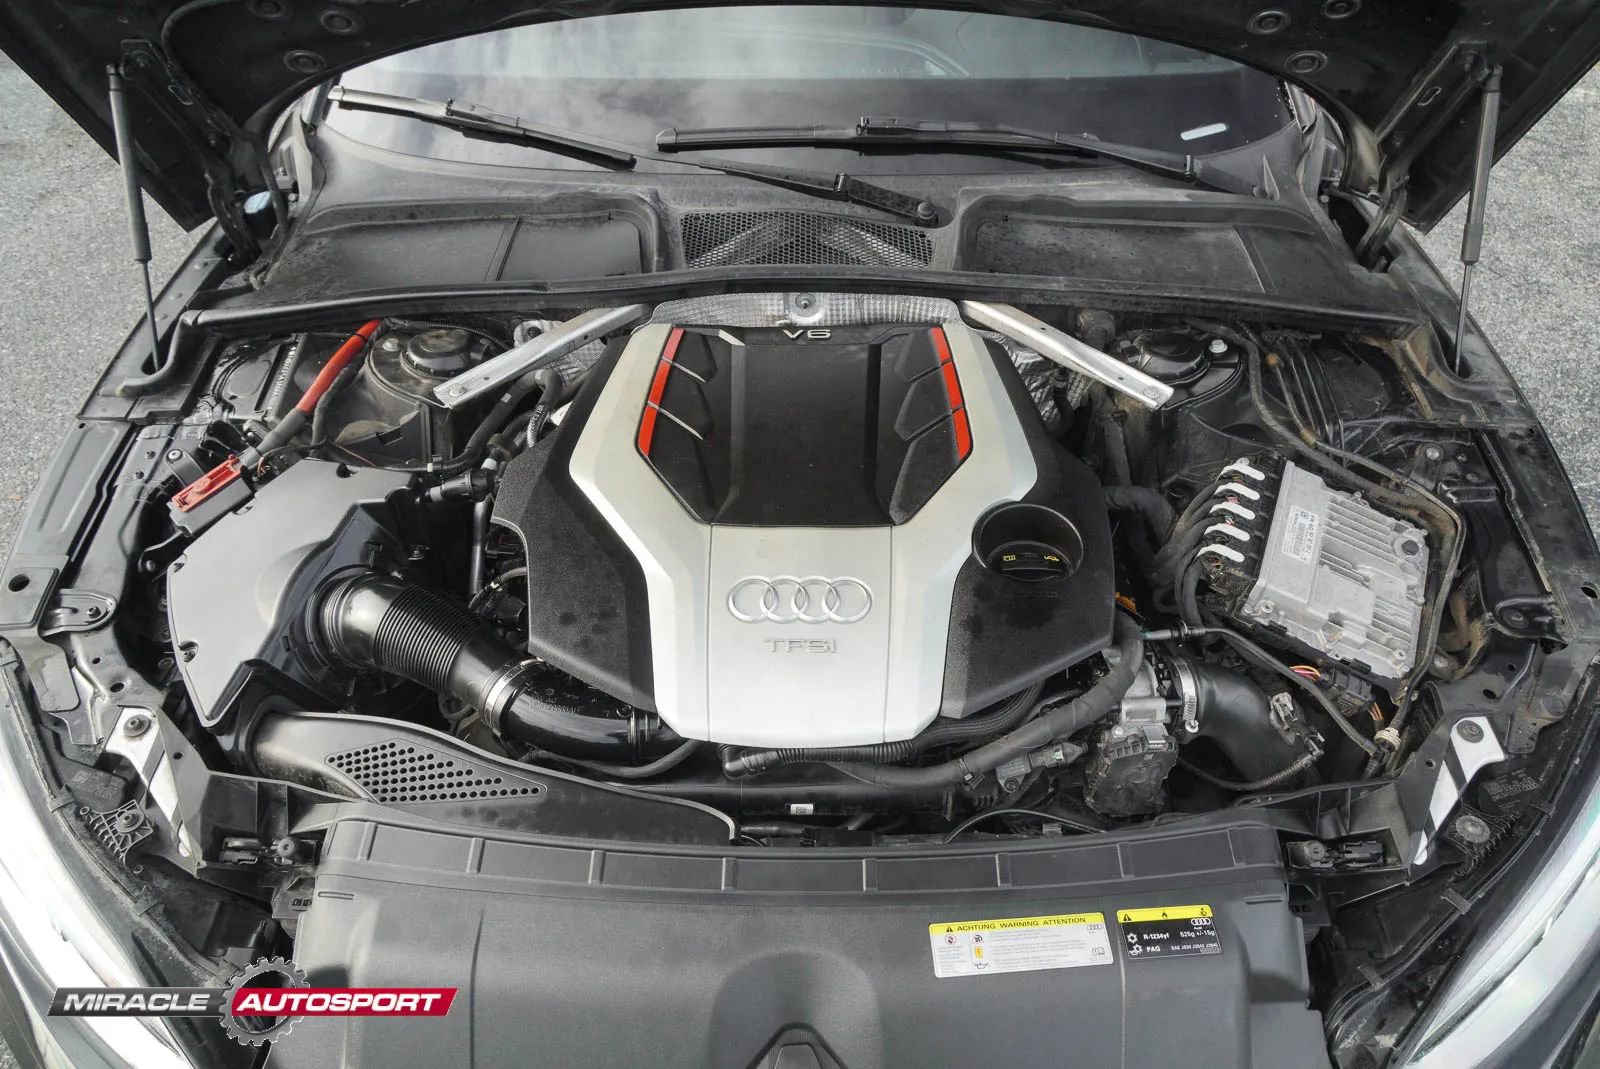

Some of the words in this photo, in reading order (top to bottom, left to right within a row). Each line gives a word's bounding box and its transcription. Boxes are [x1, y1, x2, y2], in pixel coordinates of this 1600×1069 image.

[782, 329, 832, 339] V6
[763, 638, 837, 654] TFSI
[957, 923, 996, 932] ACHTUNG
[999, 920, 1039, 929] WARNING
[1042, 917, 1086, 926] ATTENTION
[1143, 932, 1170, 940] R-1234yf
[1146, 945, 1161, 953] PAG
